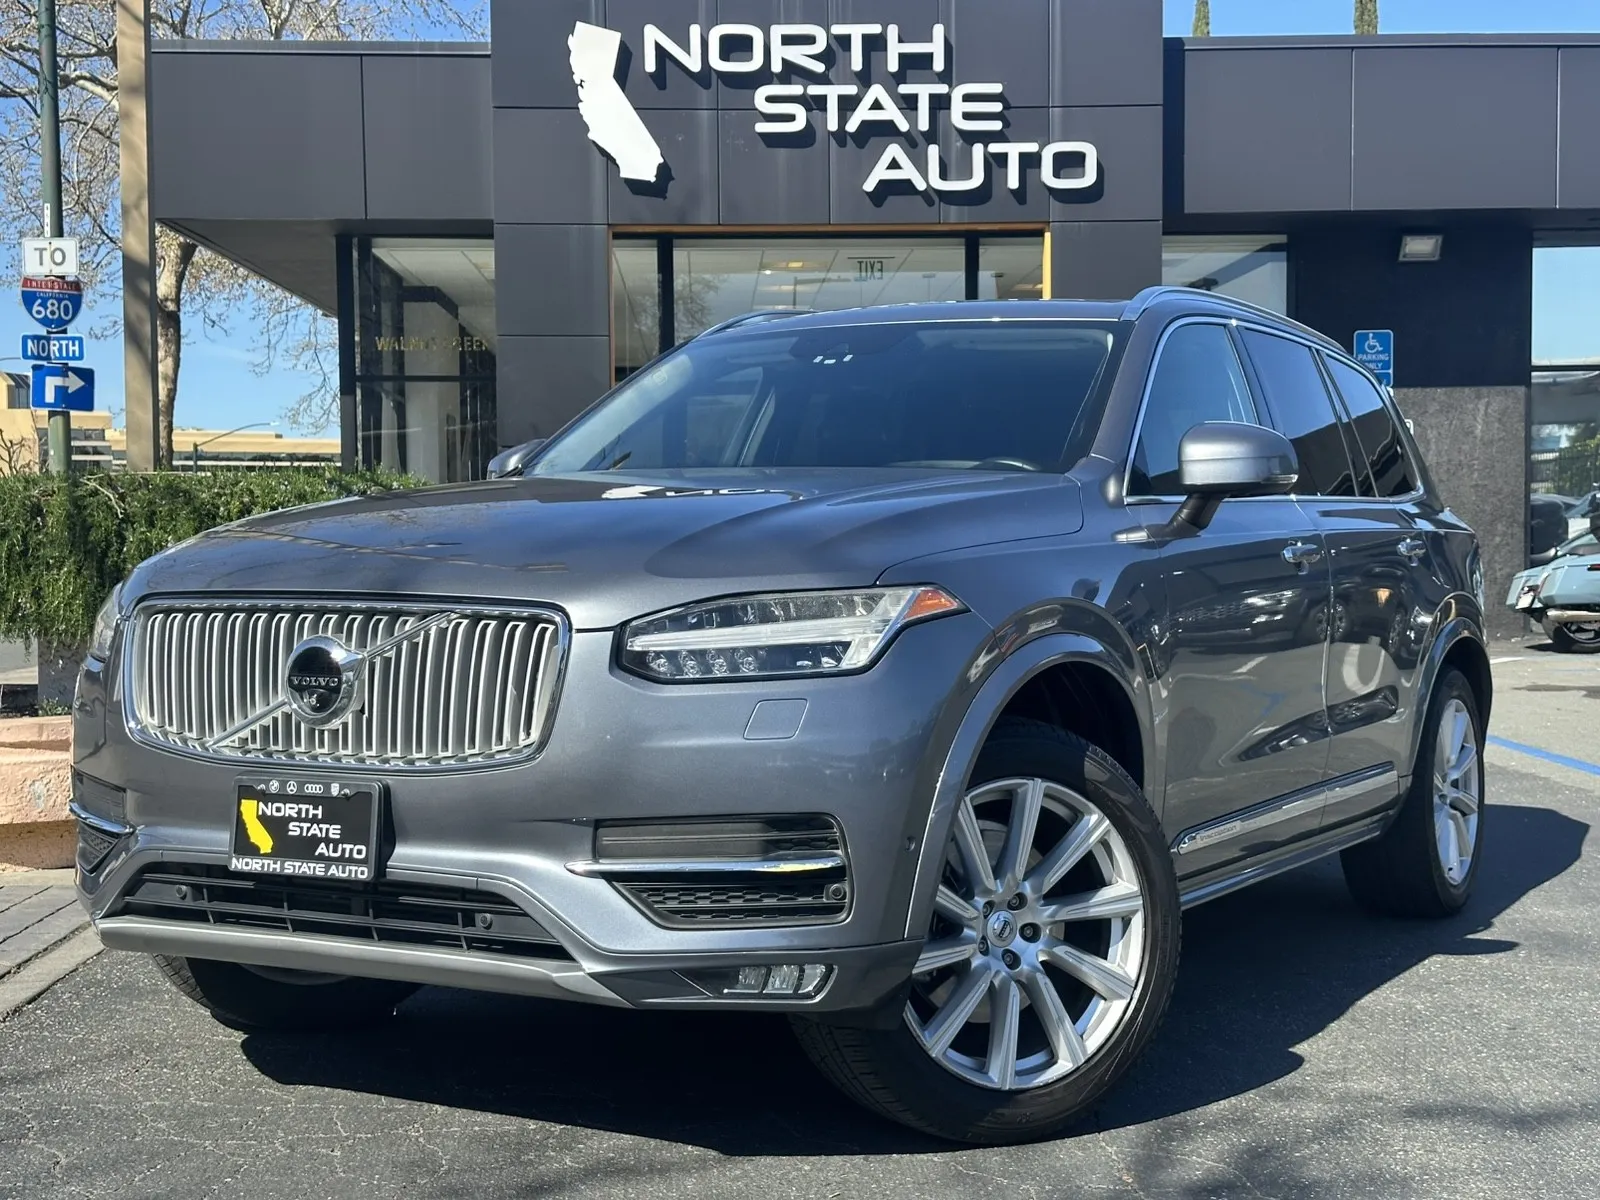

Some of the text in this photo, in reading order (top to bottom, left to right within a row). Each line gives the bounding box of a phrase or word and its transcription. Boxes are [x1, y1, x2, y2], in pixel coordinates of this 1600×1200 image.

[643, 23, 945, 73] NORTH
[753, 83, 1004, 133] STATE
[862, 141, 1098, 192] AUTO
[34, 247, 66, 266] TO
[27, 281, 78, 290] INTERSTATE
[32, 299, 72, 320] 680
[27, 339, 79, 357] NORTH
[1357, 353, 1389, 361] PARKING
[290, 676, 339, 686] VOLVO
[258, 801, 322, 819] NORTH
[288, 822, 341, 839] STATE
[315, 842, 367, 859] AUTO
[231, 857, 368, 879] NORTH STATE AUTO
